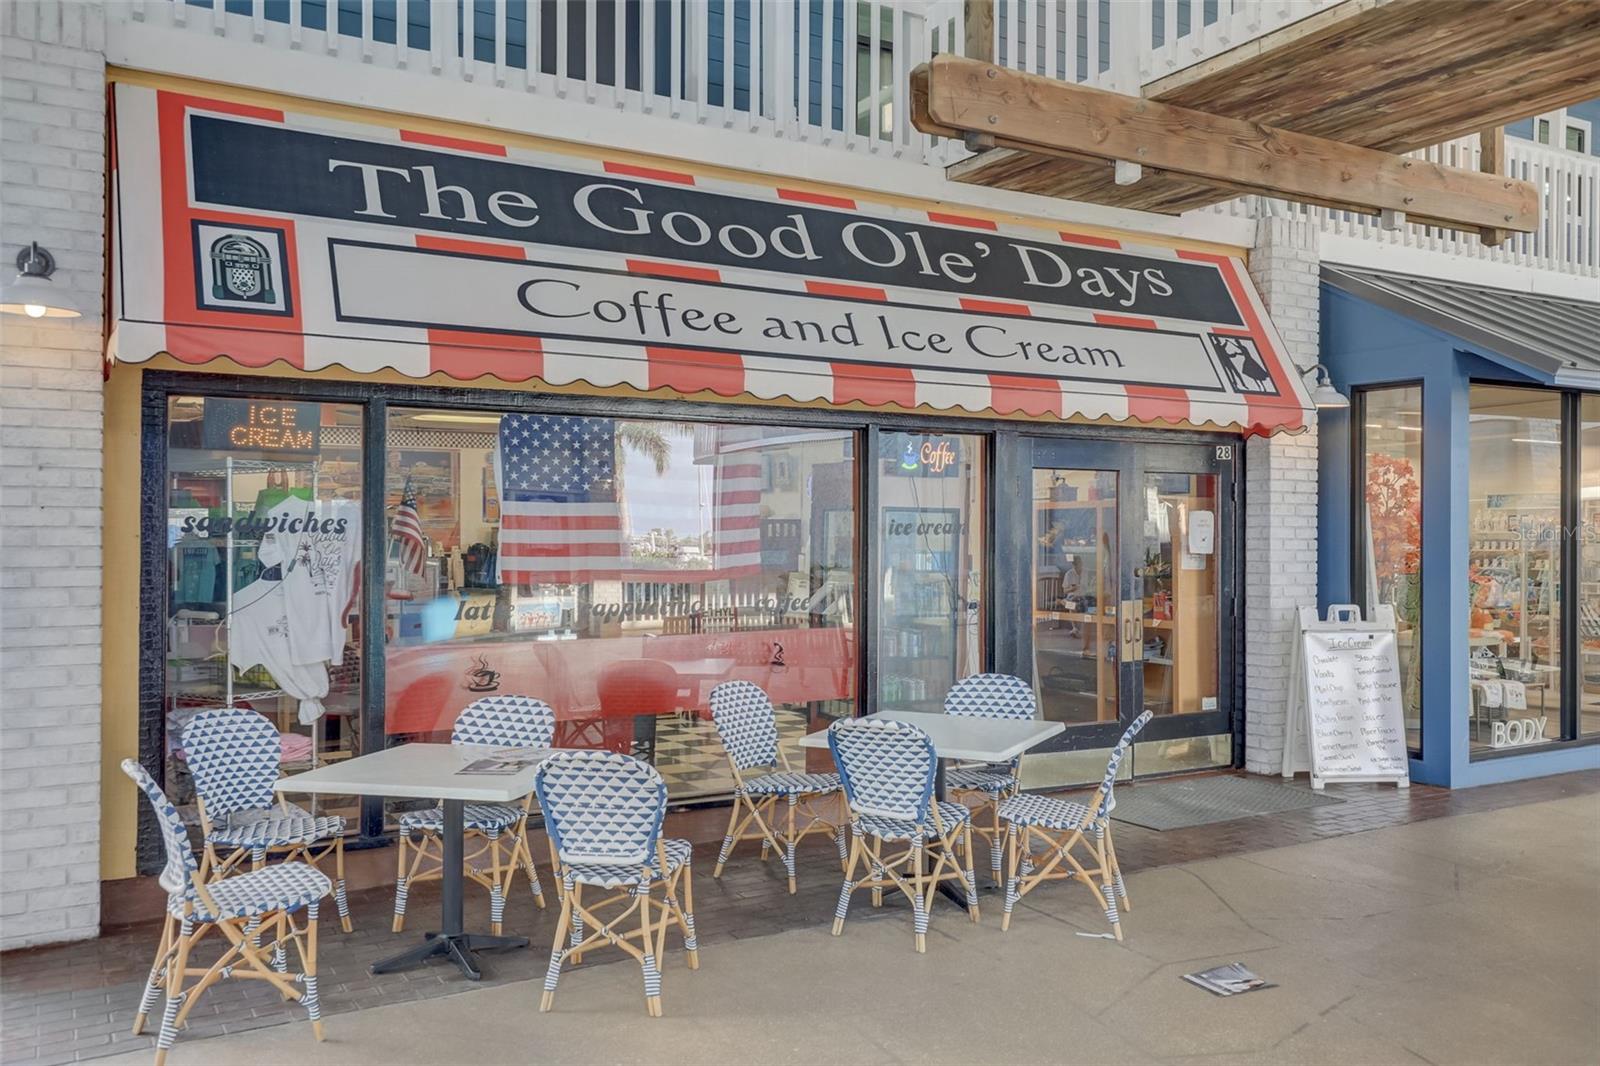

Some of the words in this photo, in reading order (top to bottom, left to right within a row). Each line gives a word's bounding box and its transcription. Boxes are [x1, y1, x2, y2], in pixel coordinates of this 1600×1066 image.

[329, 159, 540, 228] The
[573, 183, 823, 261] Good
[1008, 243, 1174, 307] Days
[517, 279, 743, 337] Coffee
[762, 312, 864, 347] and
[877, 315, 953, 354] Ice
[965, 325, 1126, 369] Cream
[249, 405, 297, 427] ICE
[230, 426, 313, 449] CREAM
[920, 441, 956, 473] Coffee
[1217, 446, 1231, 459] 28
[181, 511, 348, 535] sandwiches
[888, 519, 913, 536] ice
[1491, 716, 1548, 746] BODY
